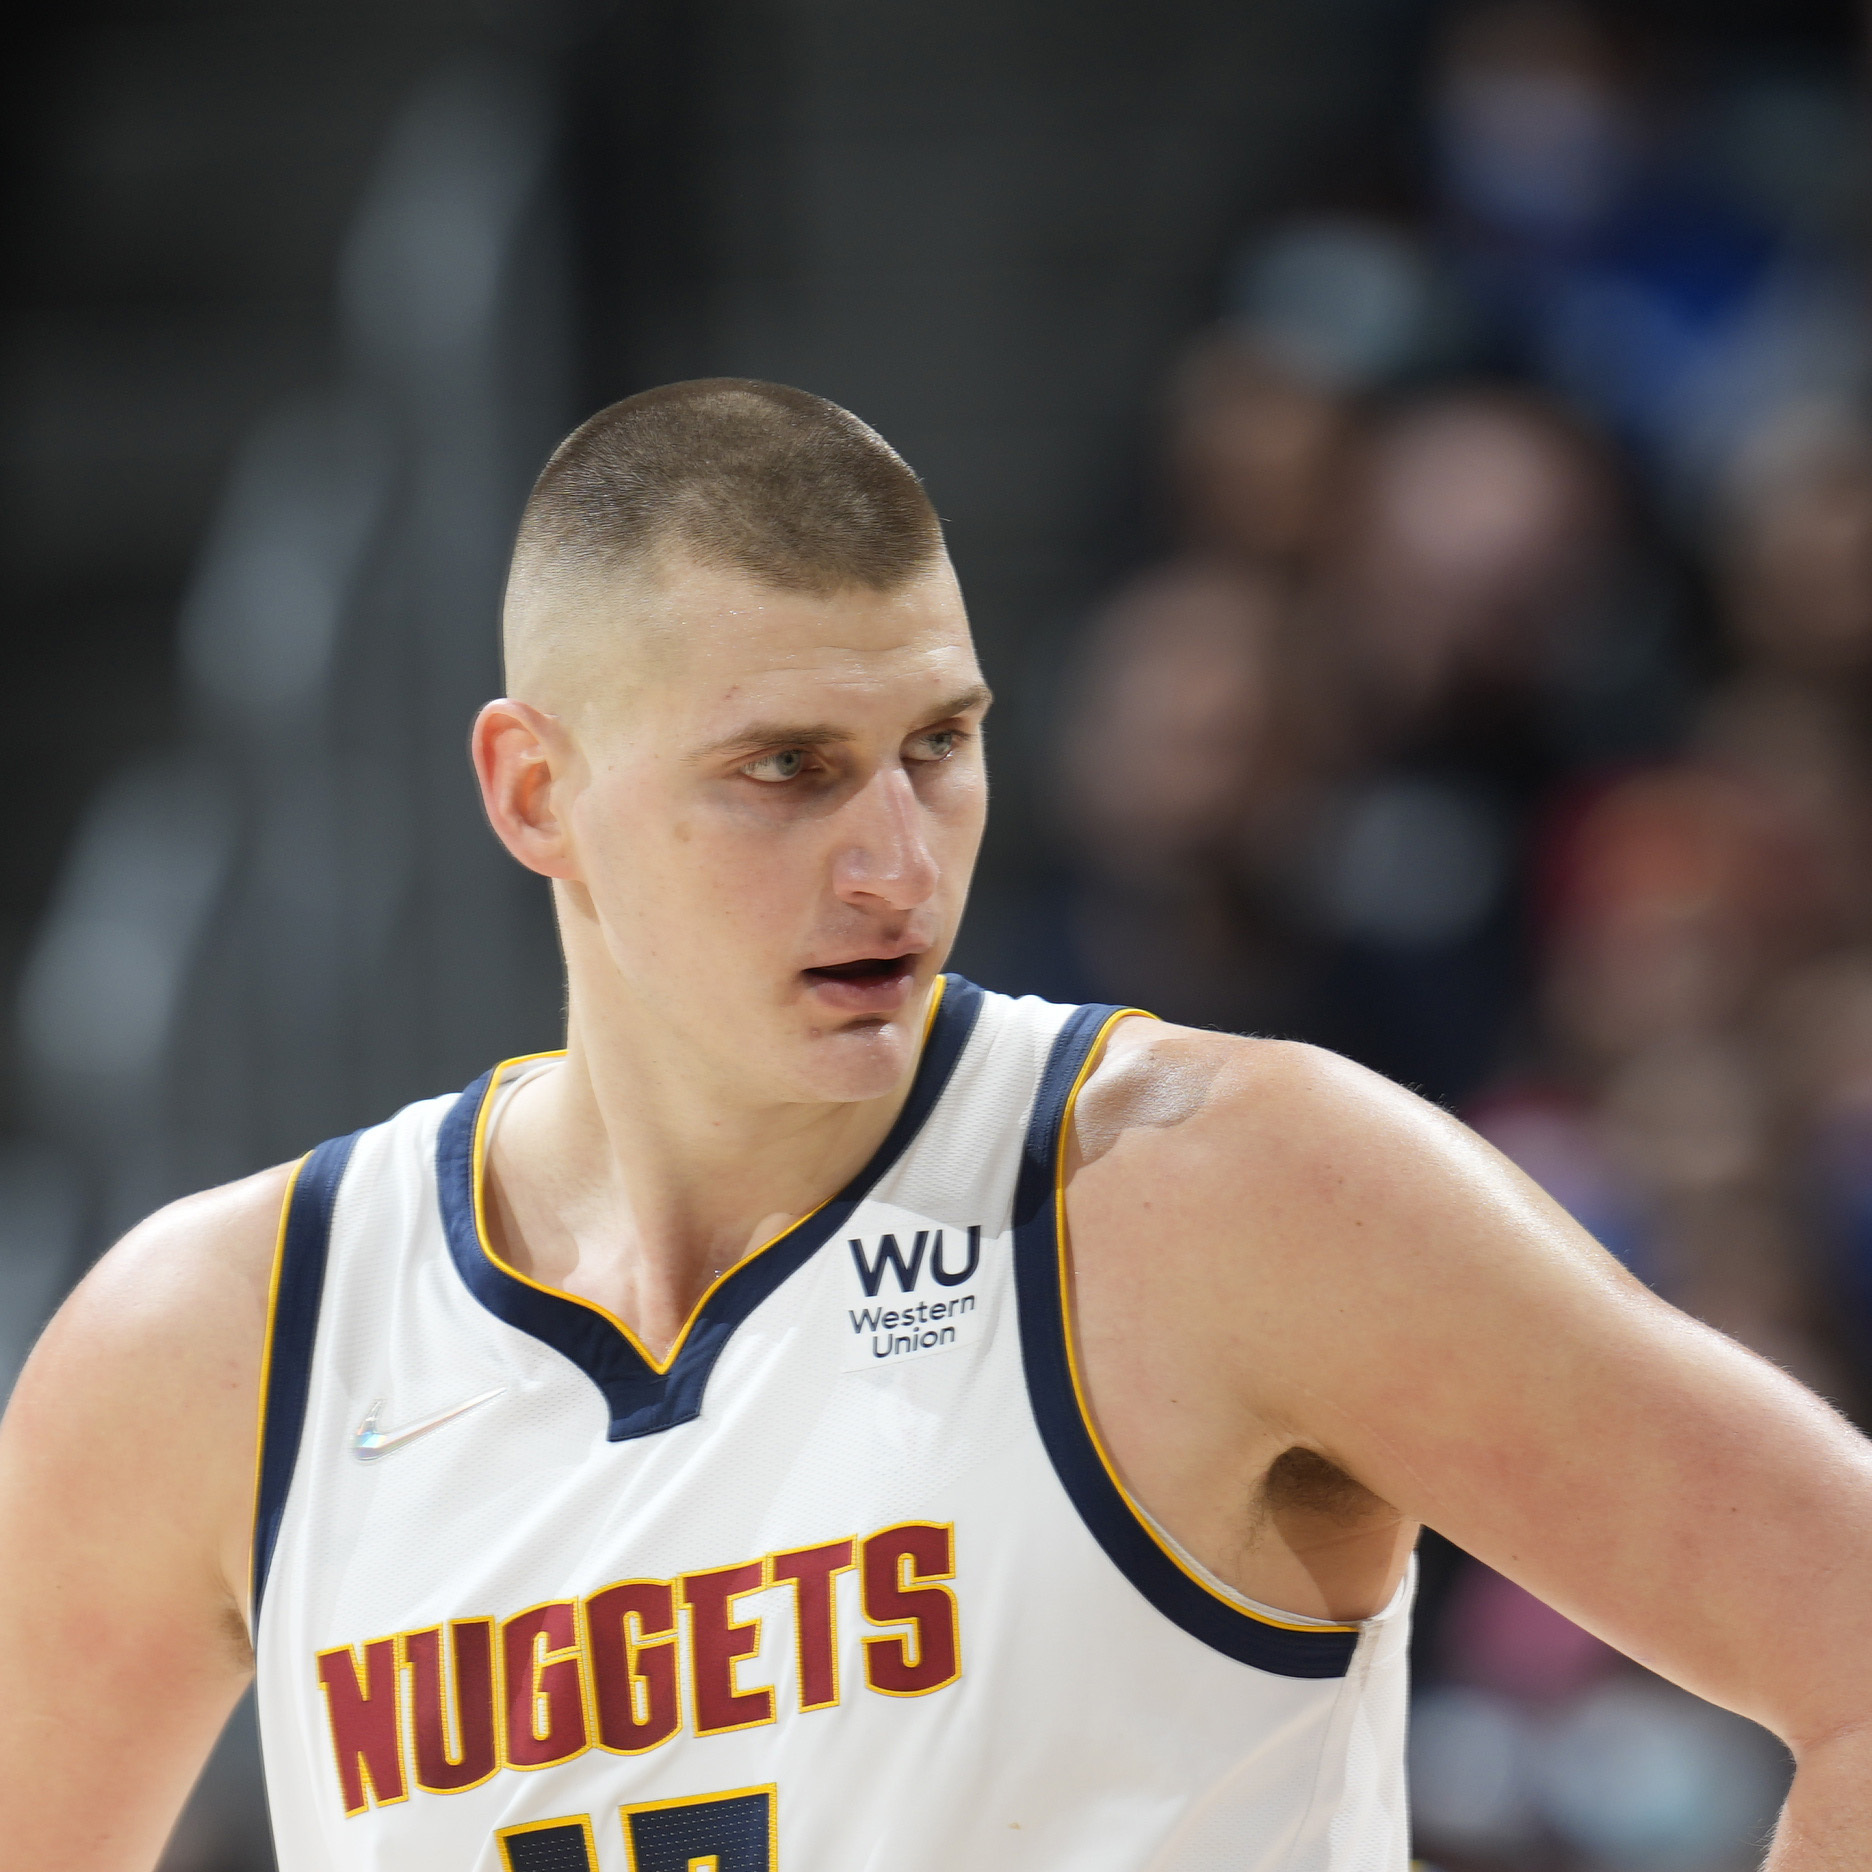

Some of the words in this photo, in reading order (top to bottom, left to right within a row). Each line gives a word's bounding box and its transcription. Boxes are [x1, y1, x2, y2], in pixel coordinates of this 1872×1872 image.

[847, 1224, 982, 1298] WU
[848, 1294, 976, 1335] Western
[872, 1326, 956, 1359] Union
[316, 1520, 962, 1818] NUGGETS
